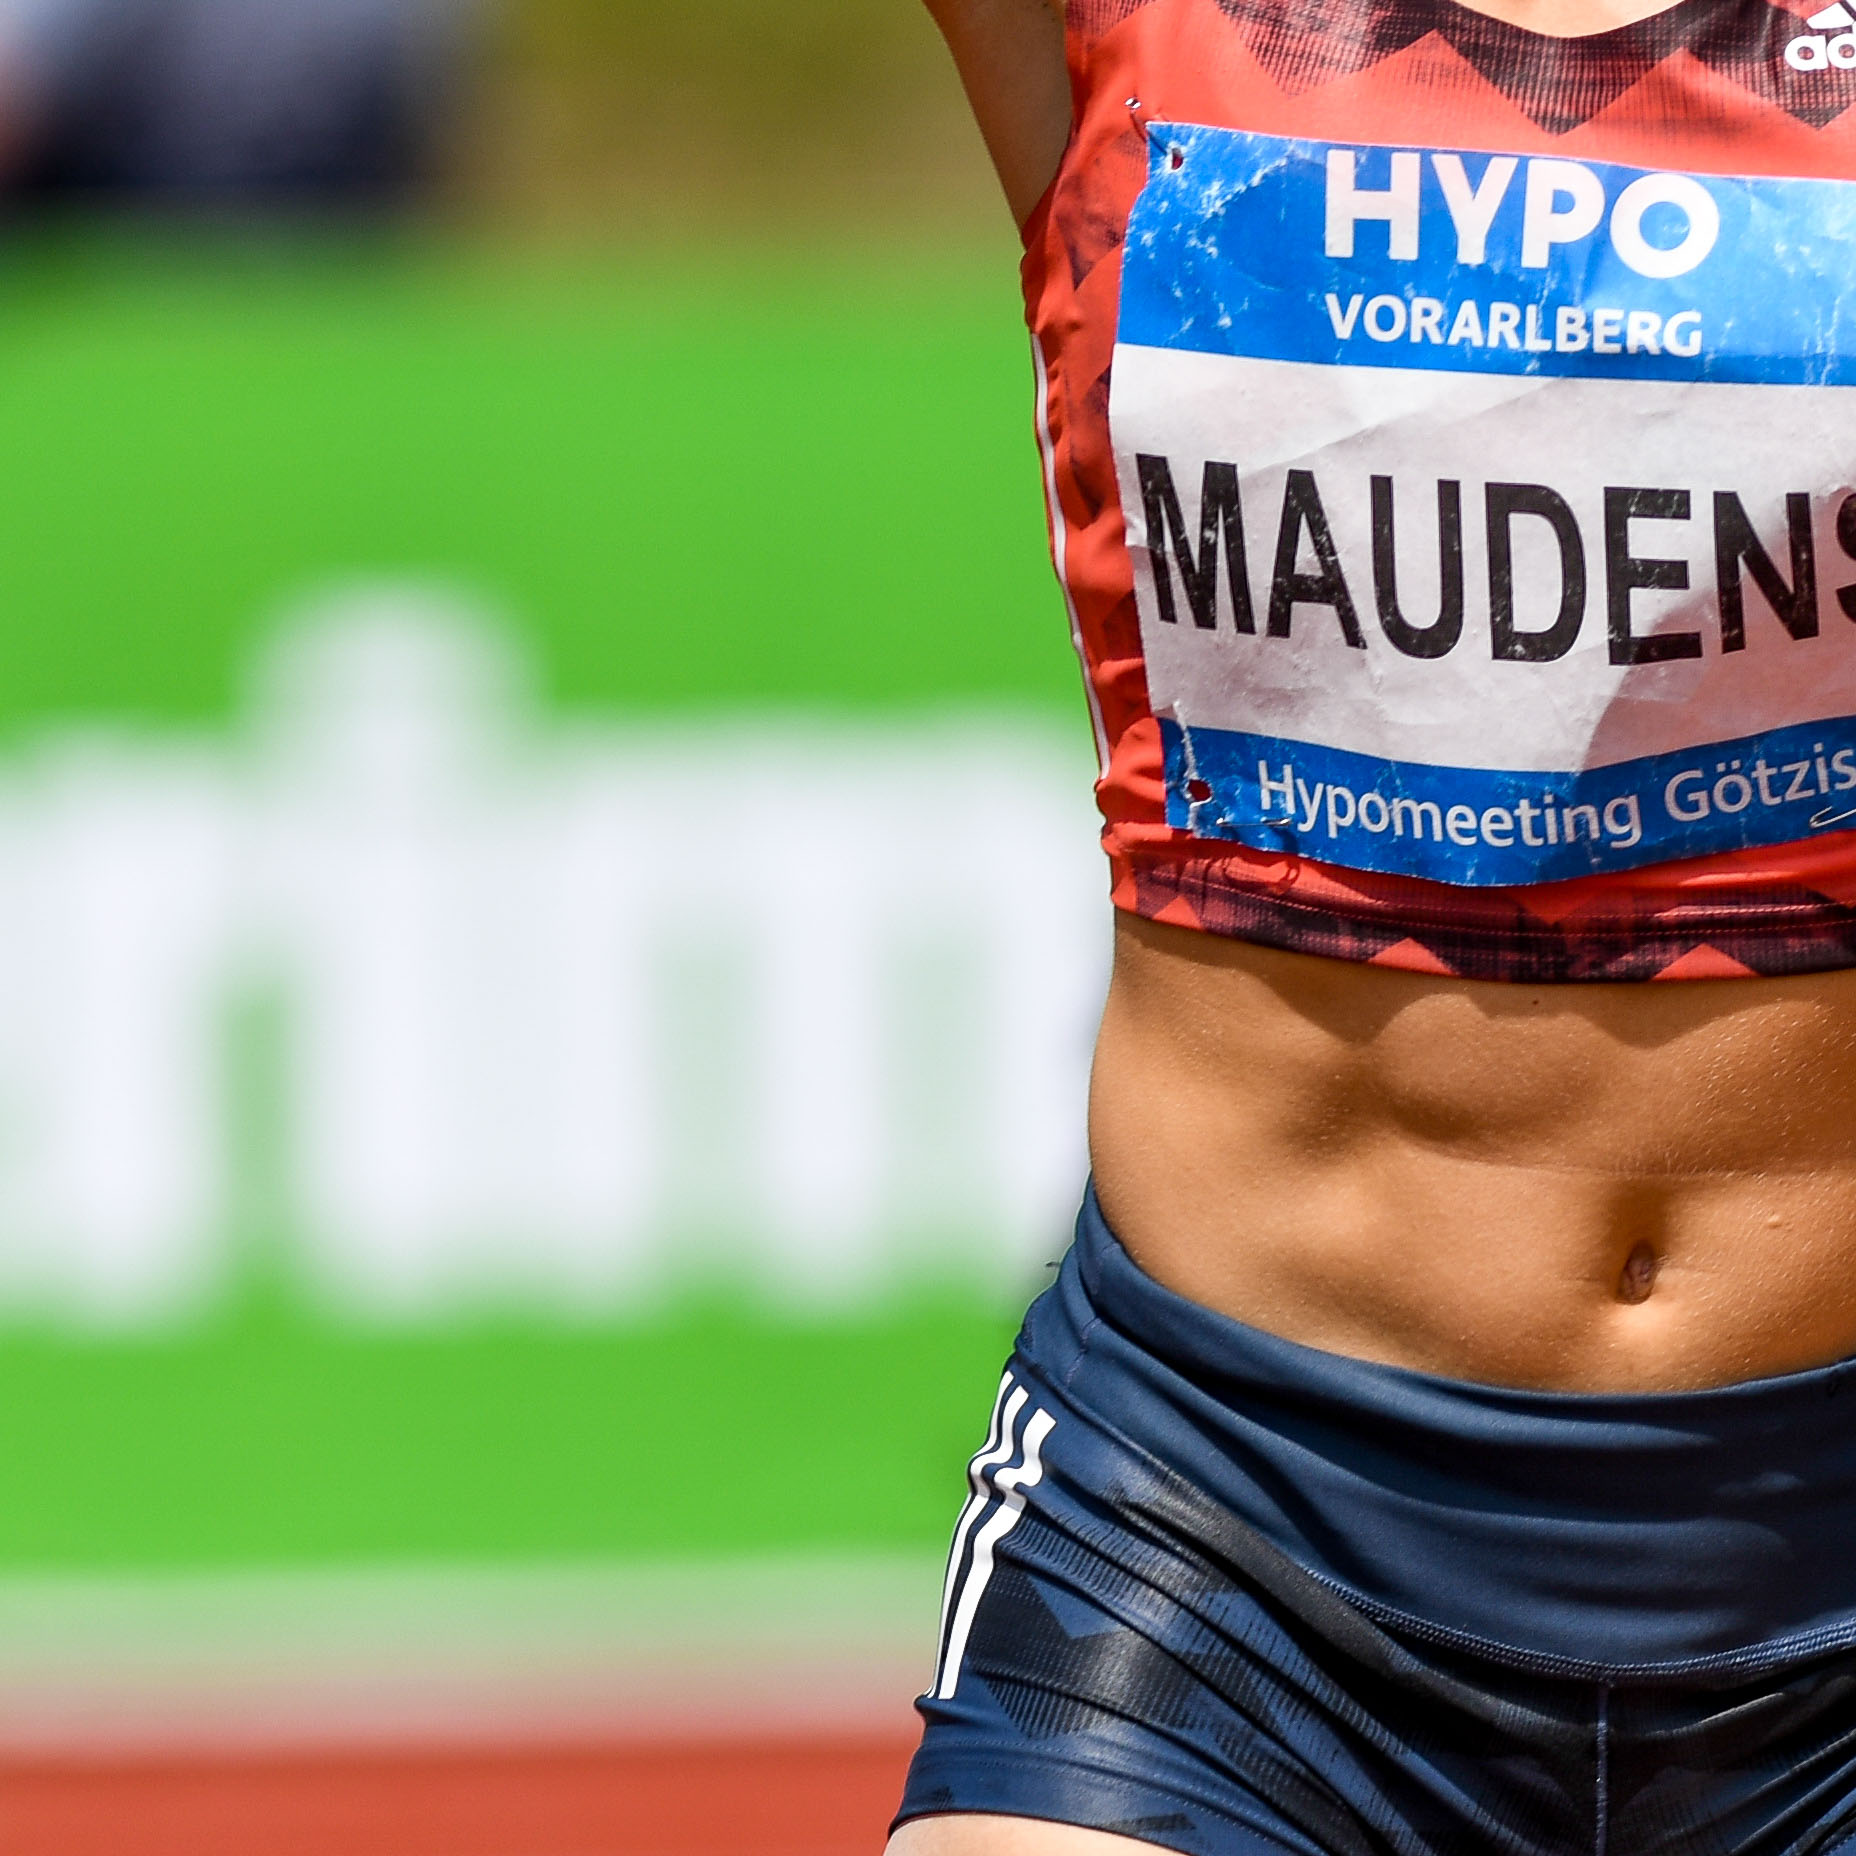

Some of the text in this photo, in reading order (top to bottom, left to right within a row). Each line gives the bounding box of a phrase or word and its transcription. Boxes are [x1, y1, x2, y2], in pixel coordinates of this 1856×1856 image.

[1324, 148, 1721, 280] HYPO
[1324, 292, 1704, 358] VORARLBERG
[1257, 758, 1643, 850] Hypomeeting
